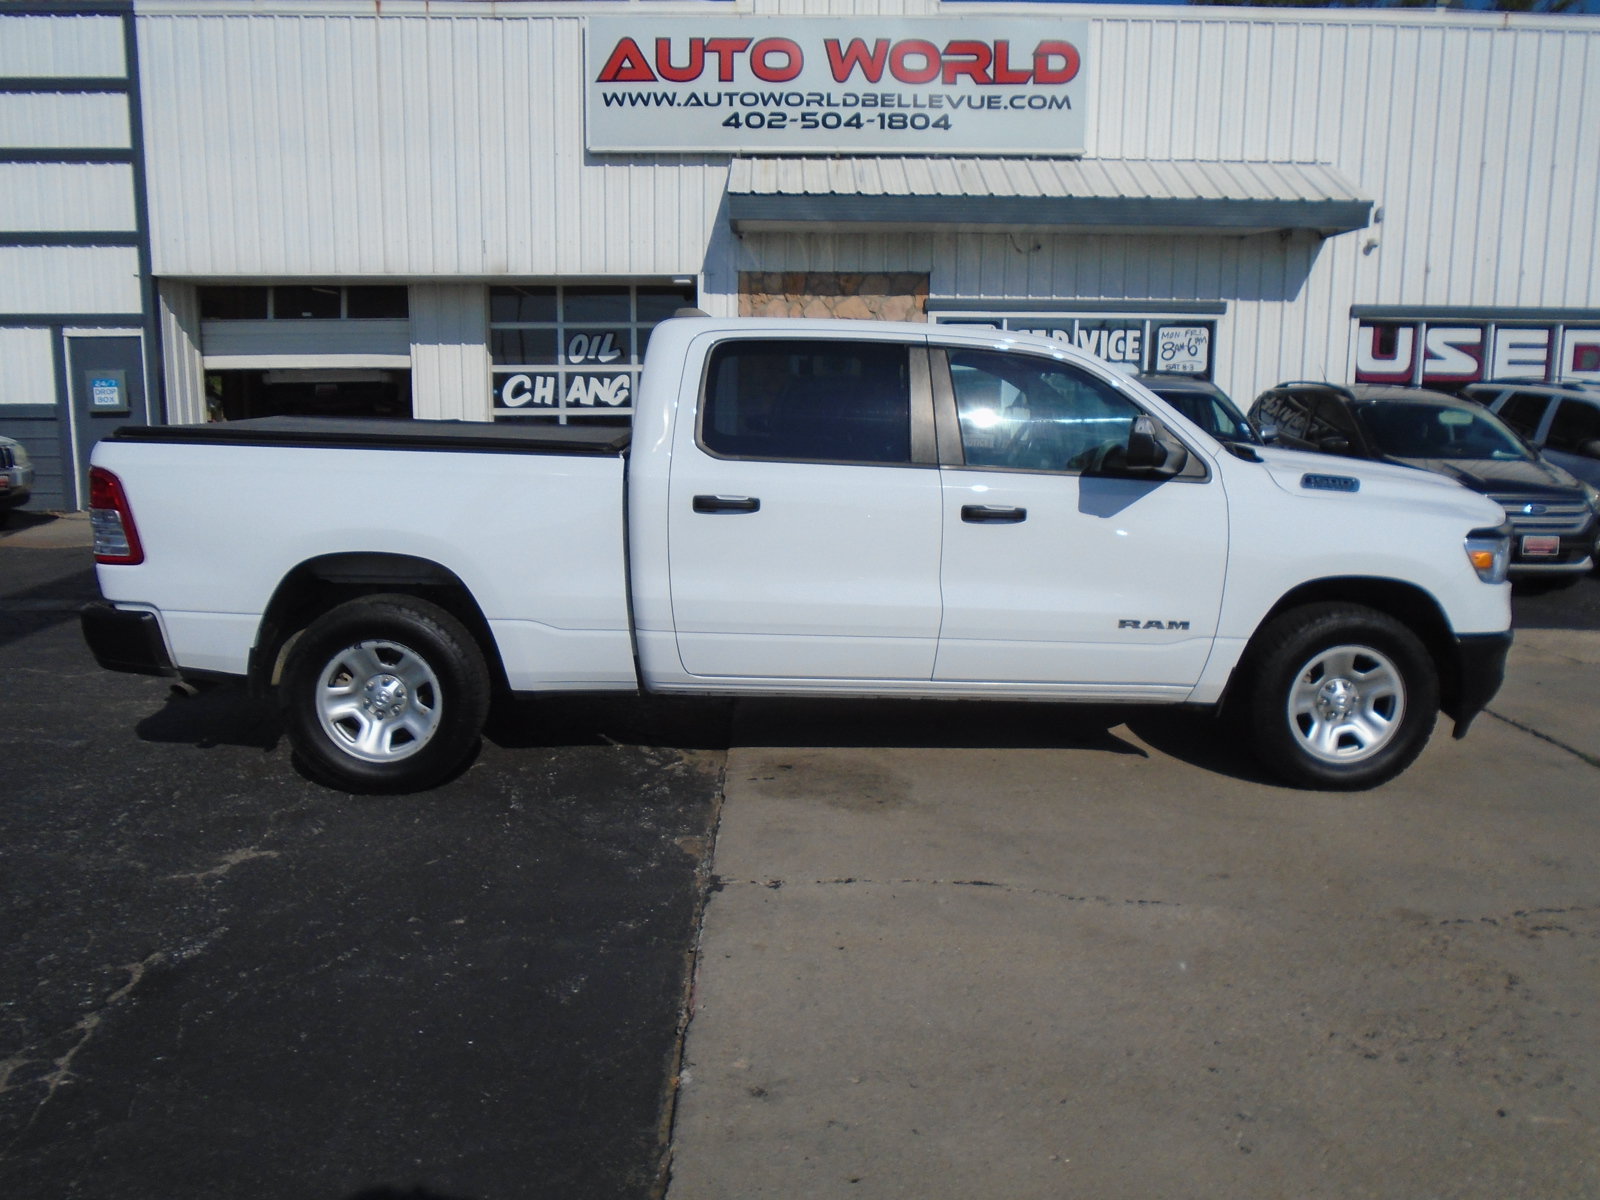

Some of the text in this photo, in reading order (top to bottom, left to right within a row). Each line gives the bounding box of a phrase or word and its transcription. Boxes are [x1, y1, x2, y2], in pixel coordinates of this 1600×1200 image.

[595, 36, 1081, 85] AUTO WORLD
[602, 91, 1072, 111] WWW.AUTOWORLDBELLEVUE.COM
[722, 111, 953, 131] 402-504-1804
[568, 333, 622, 364] OIL
[1118, 619, 1190, 630] RAM
